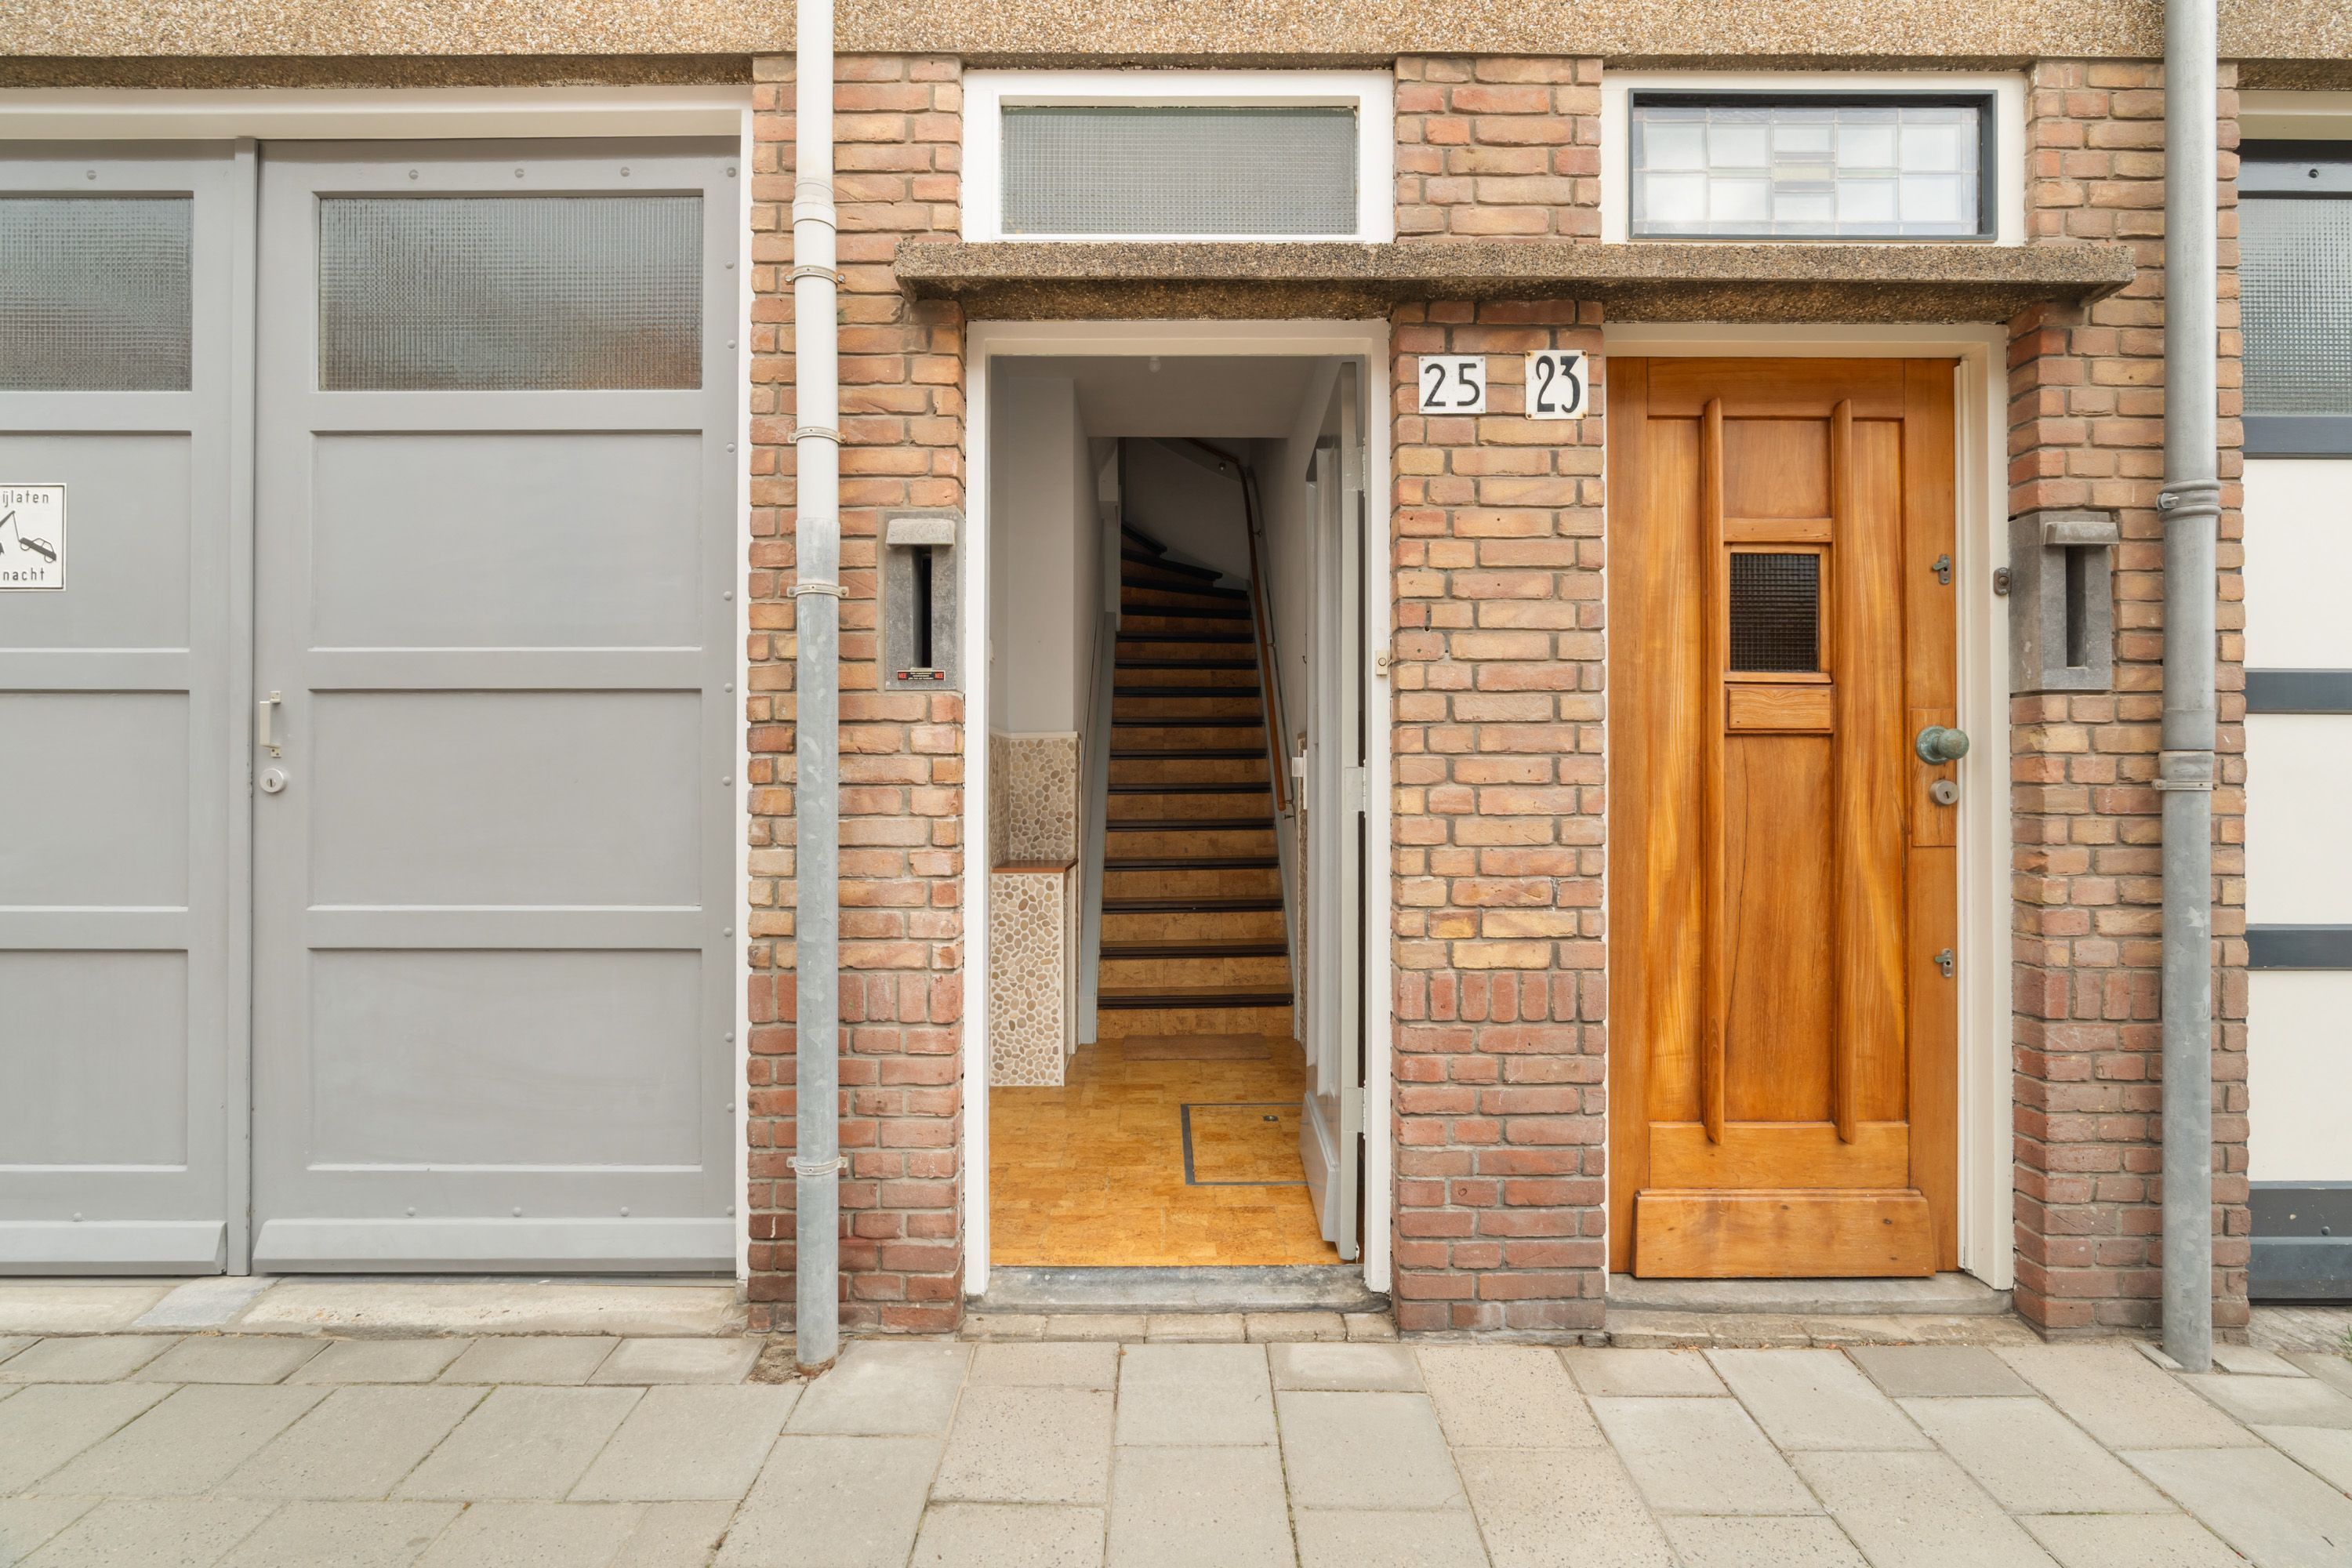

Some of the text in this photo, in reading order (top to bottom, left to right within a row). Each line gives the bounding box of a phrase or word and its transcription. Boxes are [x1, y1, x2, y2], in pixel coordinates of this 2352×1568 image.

[1424, 363, 1480, 406] 25
[1536, 355, 1581, 413] 23
[3, 568, 45, 581] nacht
